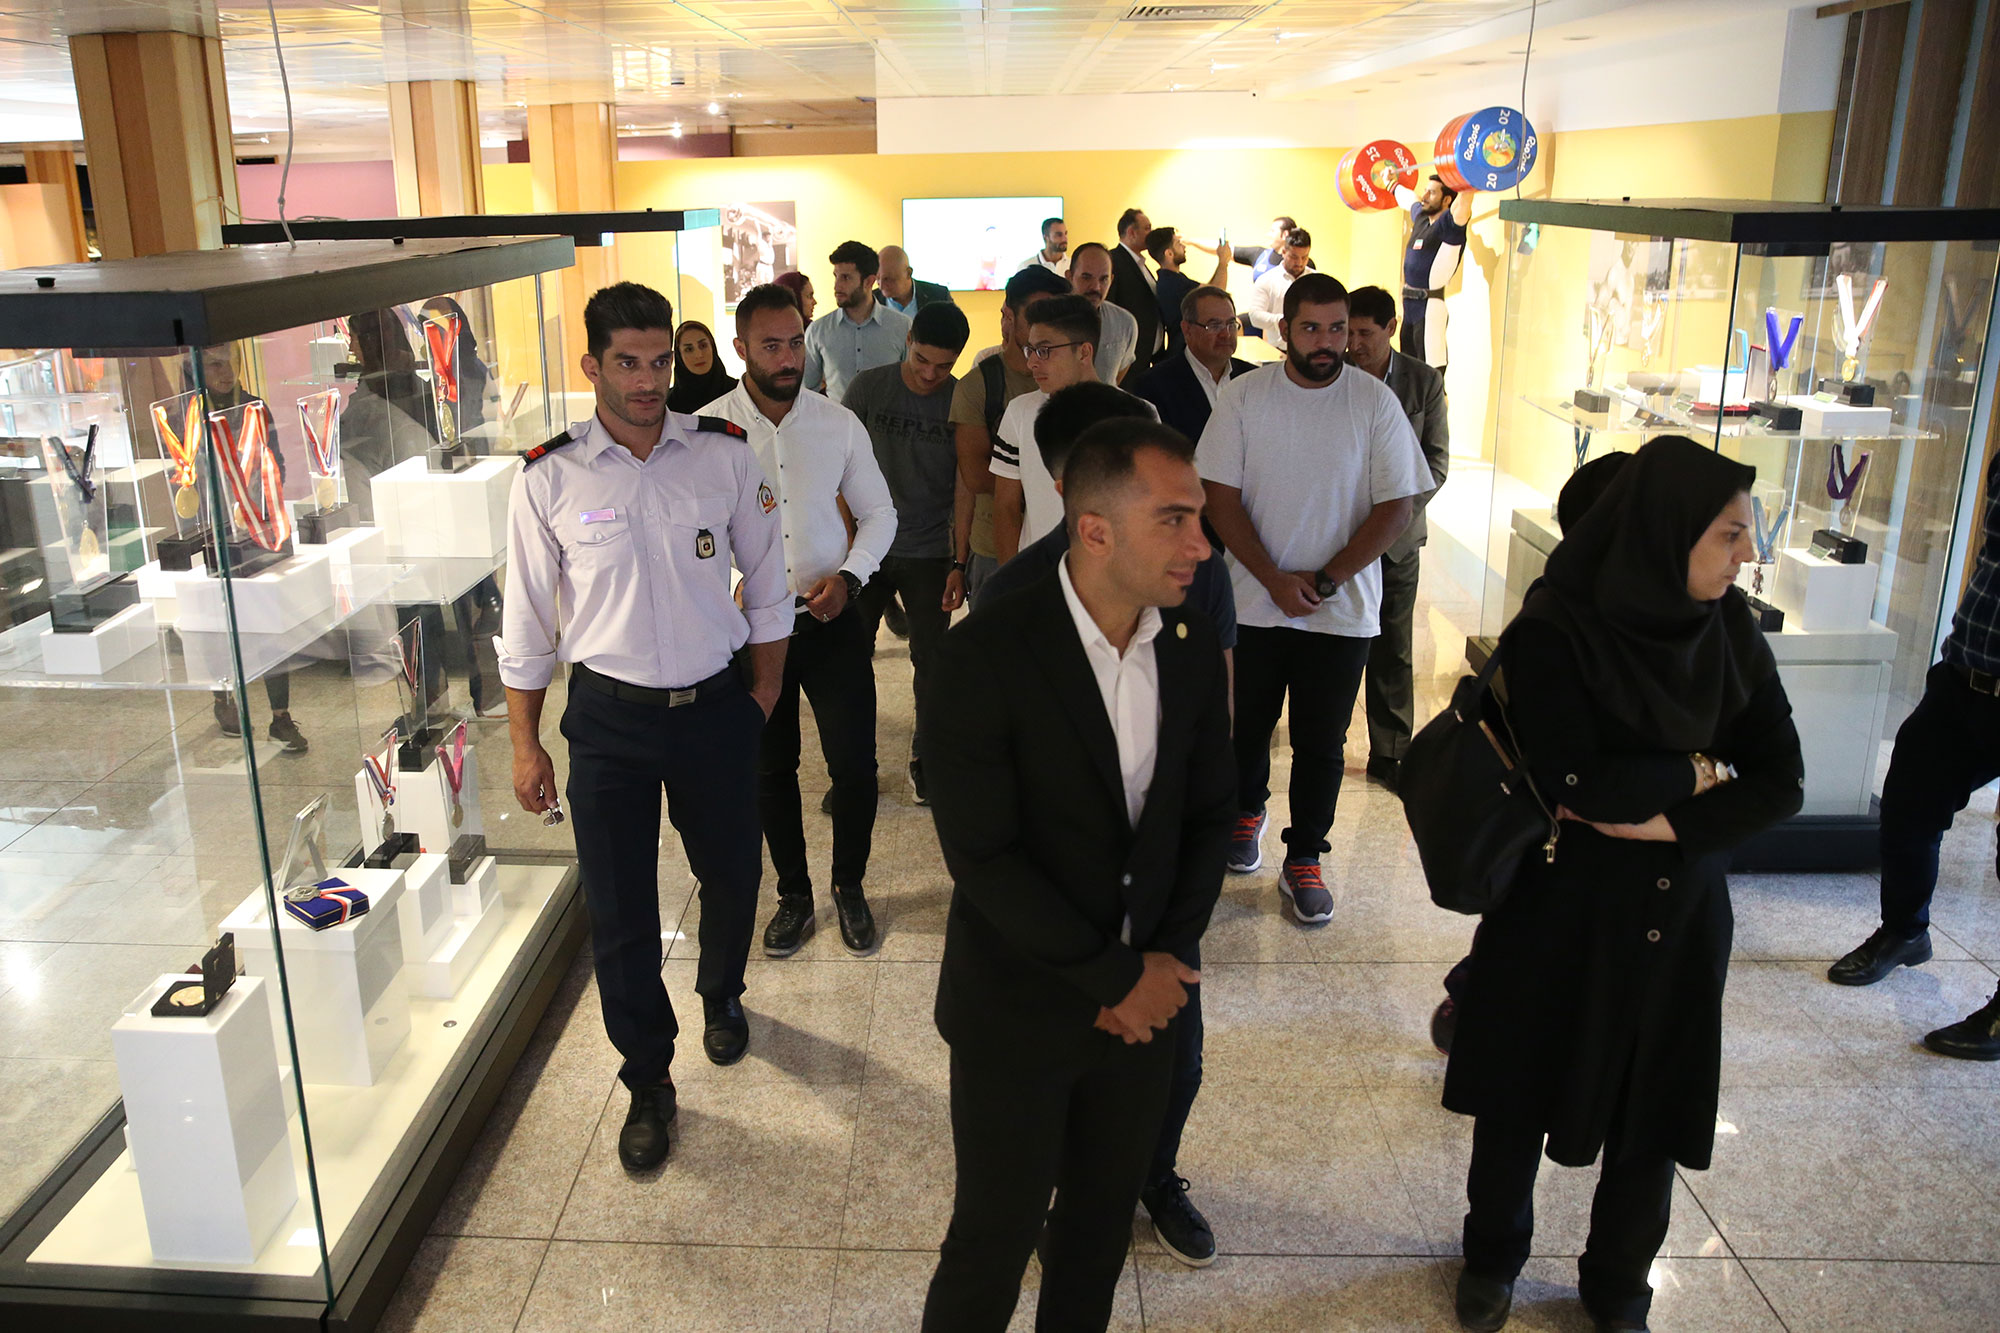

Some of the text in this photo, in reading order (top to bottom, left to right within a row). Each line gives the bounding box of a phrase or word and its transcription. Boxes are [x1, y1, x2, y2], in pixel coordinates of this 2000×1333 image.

[1499, 109, 1511, 125] 20
[1464, 123, 1481, 161] Rio2016
[1366, 146, 1381, 162] 25
[1486, 173, 1498, 189] 20
[875, 414, 955, 437] REPLAY
